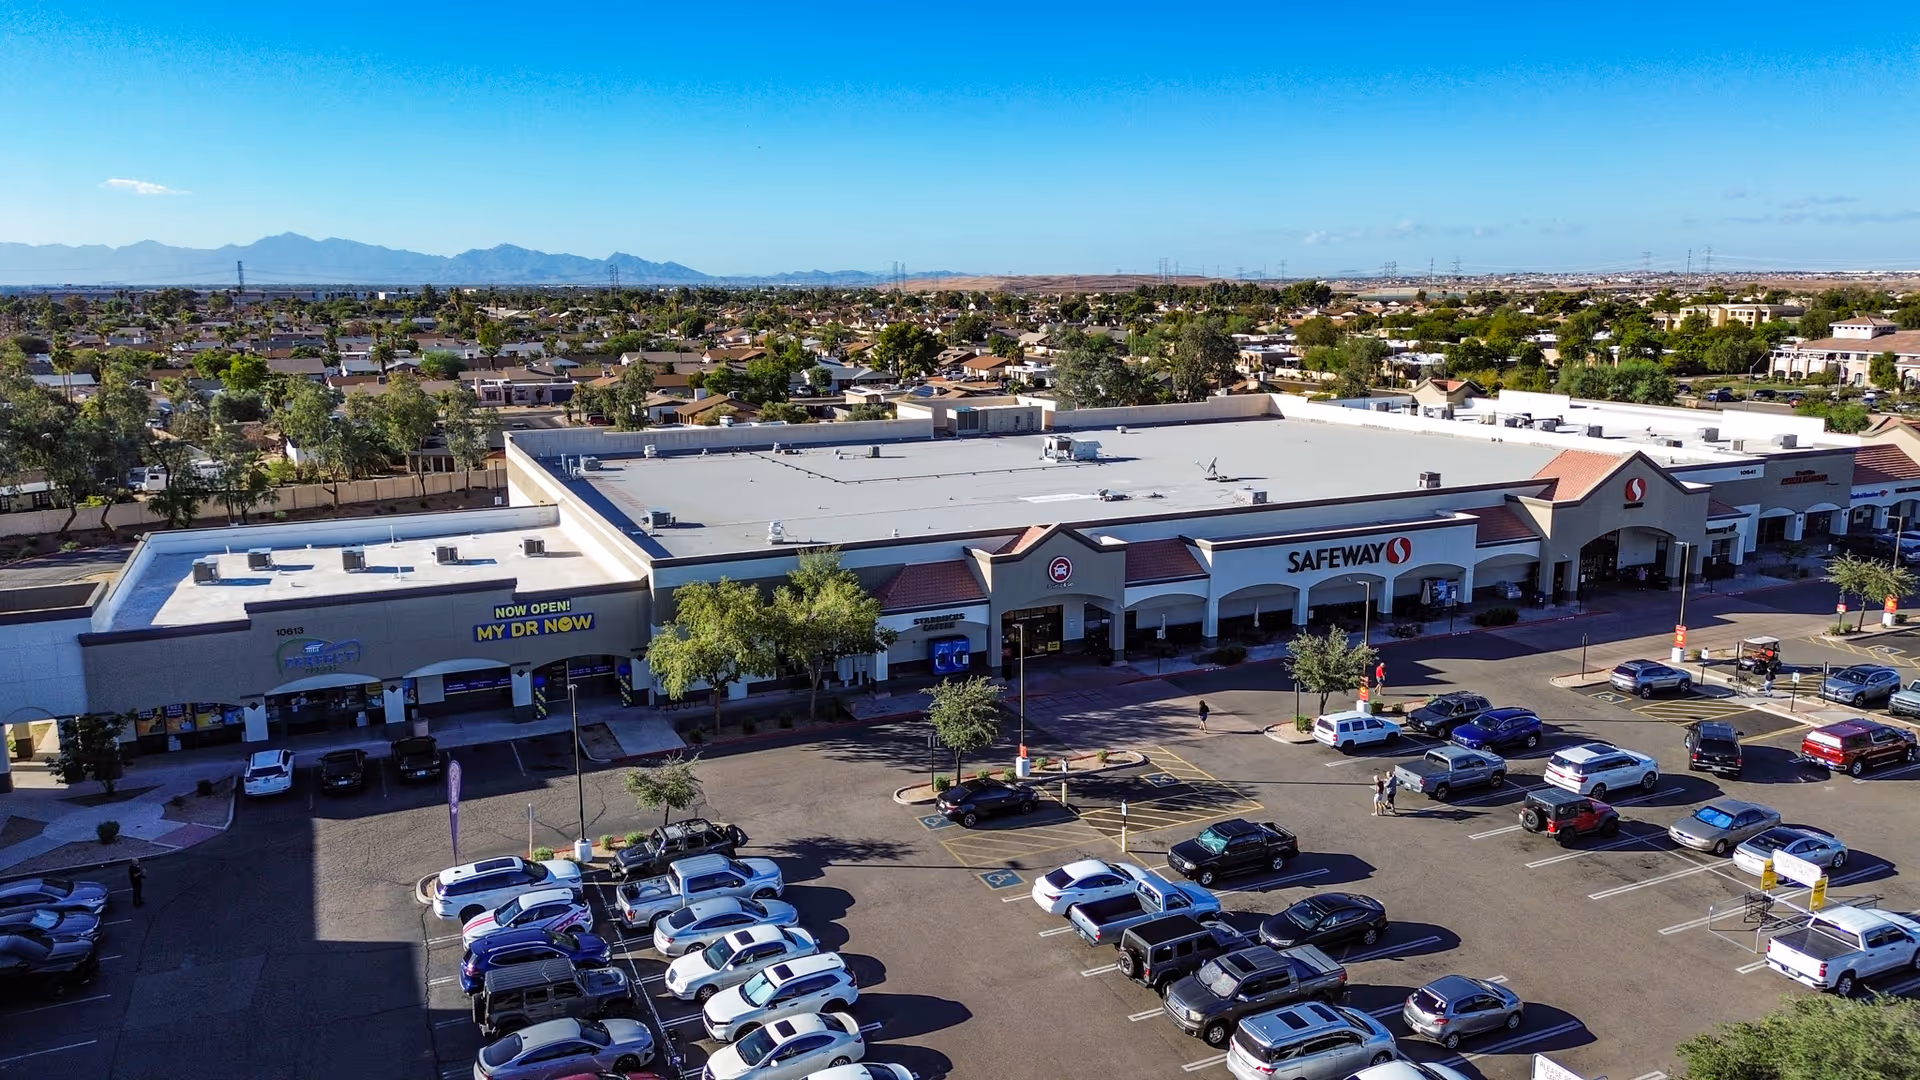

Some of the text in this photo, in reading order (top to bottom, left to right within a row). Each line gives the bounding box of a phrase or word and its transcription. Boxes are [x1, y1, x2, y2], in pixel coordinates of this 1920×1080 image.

[1287, 542, 1386, 573] SAFEWAY
[495, 600, 571, 619] NOW OPEN!
[913, 612, 966, 625] STARBUCKS
[276, 626, 305, 637] 10613
[477, 614, 593, 641] MY DR NOW
